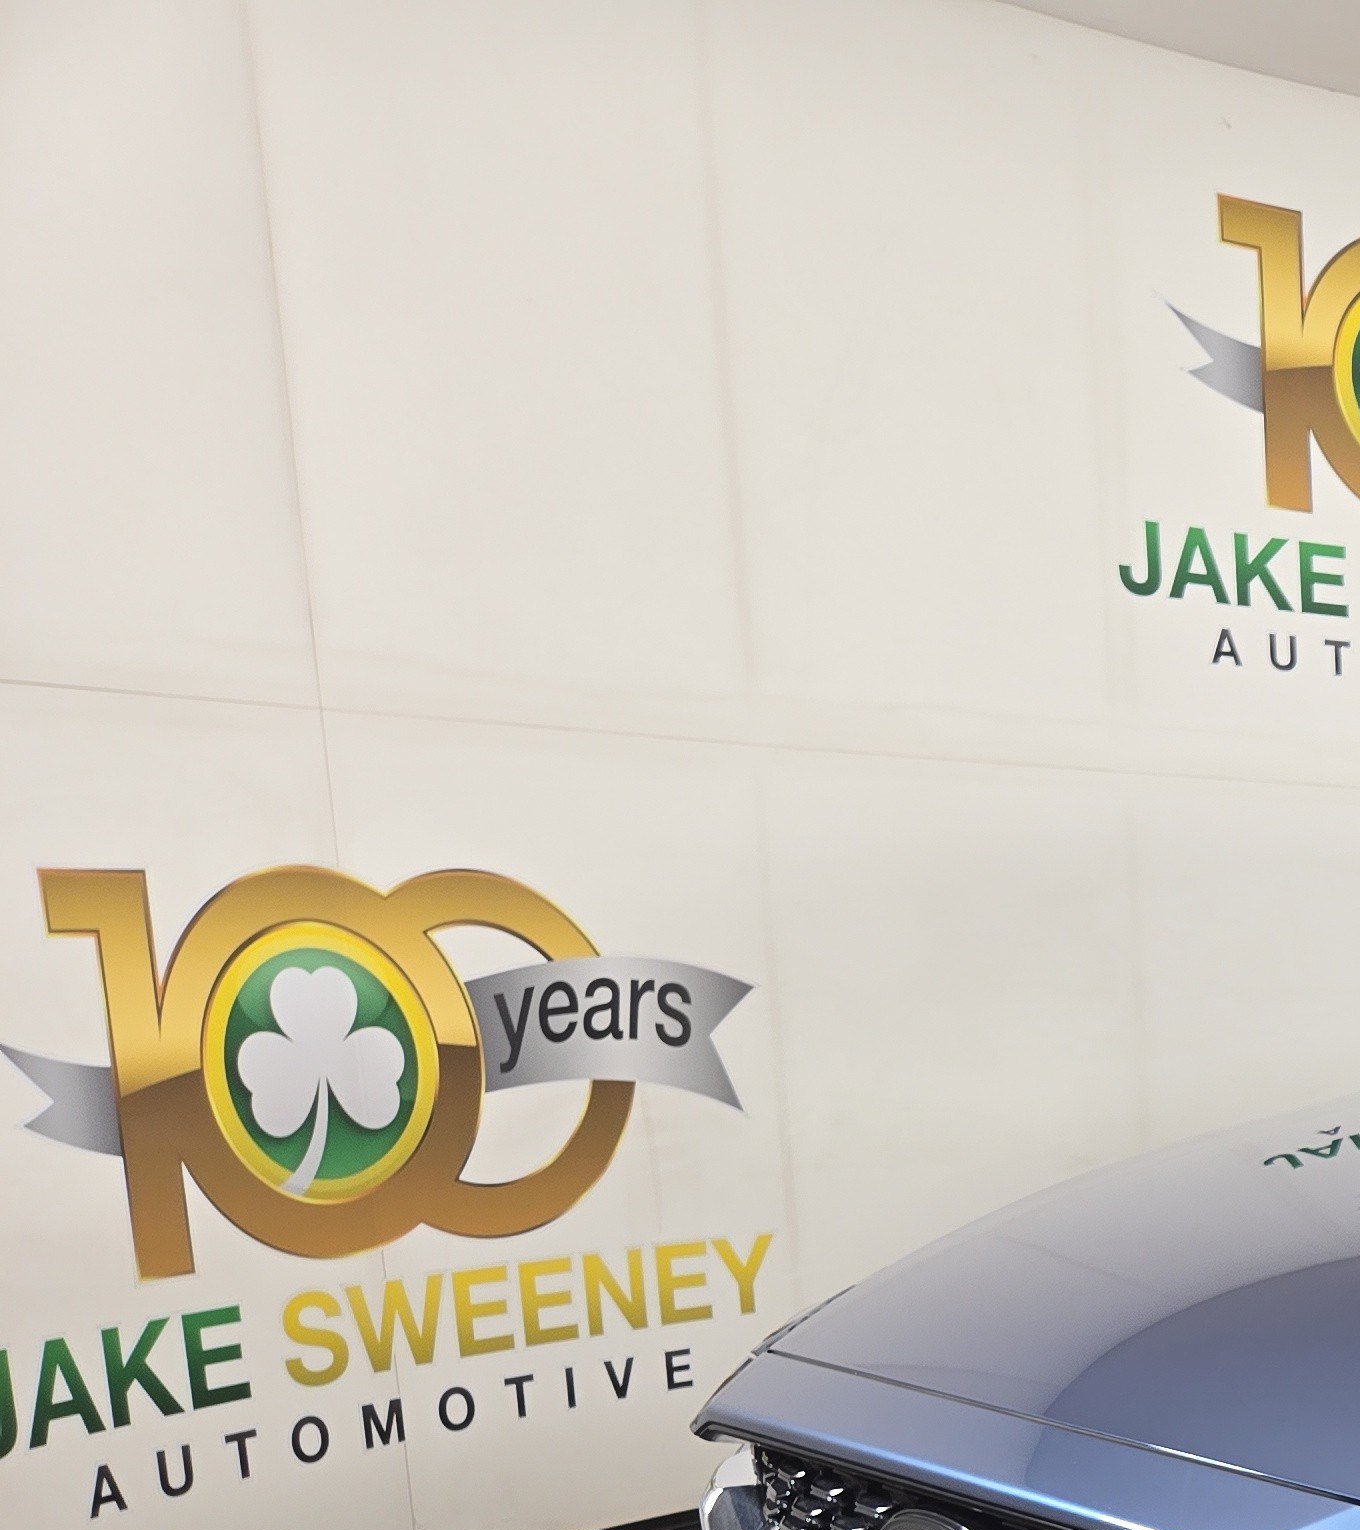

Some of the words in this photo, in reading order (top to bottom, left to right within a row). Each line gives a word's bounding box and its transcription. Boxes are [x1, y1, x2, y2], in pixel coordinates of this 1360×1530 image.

[1118, 519, 1350, 619] JAKE
[494, 977, 694, 1072] years
[282, 1233, 774, 1387] SWEENEY
[90, 1348, 695, 1519] AUTOMOTIVE
